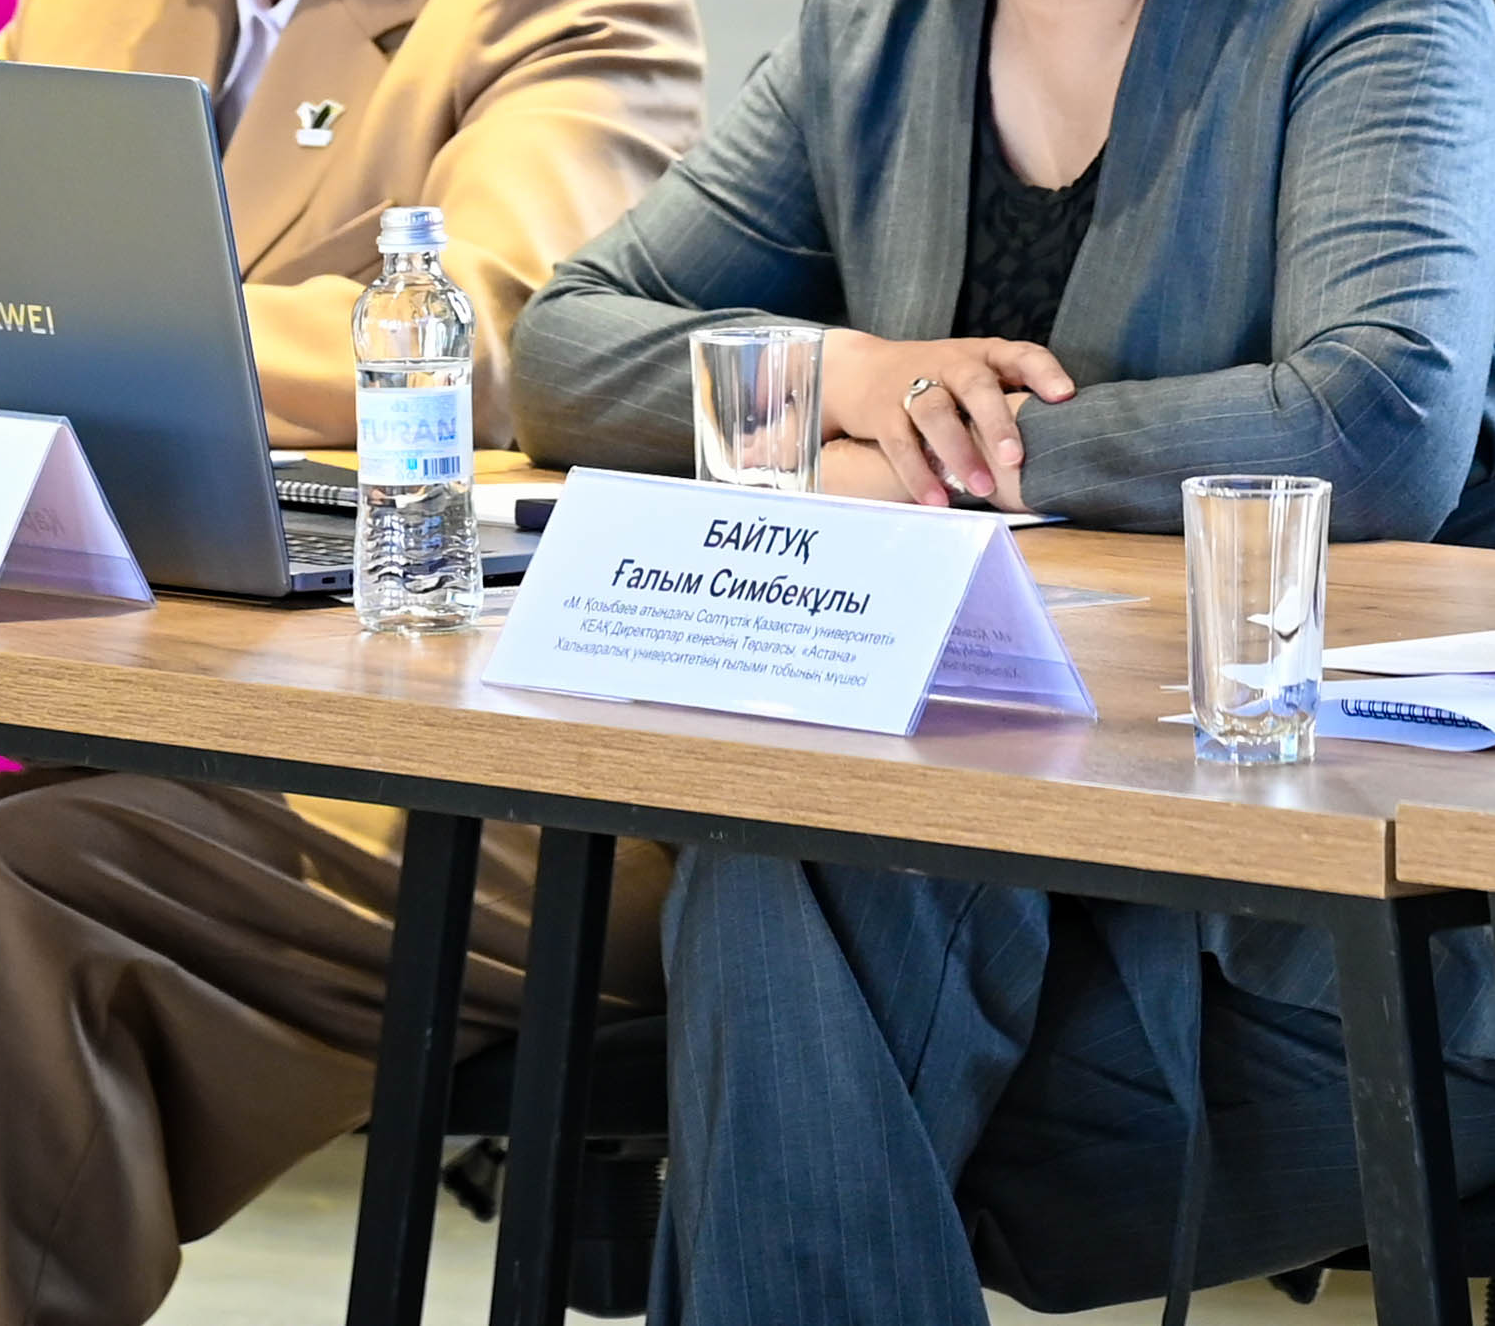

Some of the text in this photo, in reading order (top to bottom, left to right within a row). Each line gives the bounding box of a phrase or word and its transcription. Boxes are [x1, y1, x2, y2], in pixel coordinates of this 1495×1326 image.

[703, 516, 820, 565] БАЙТУҚ
[612, 558, 871, 617] Ғалым Симбекұлы
